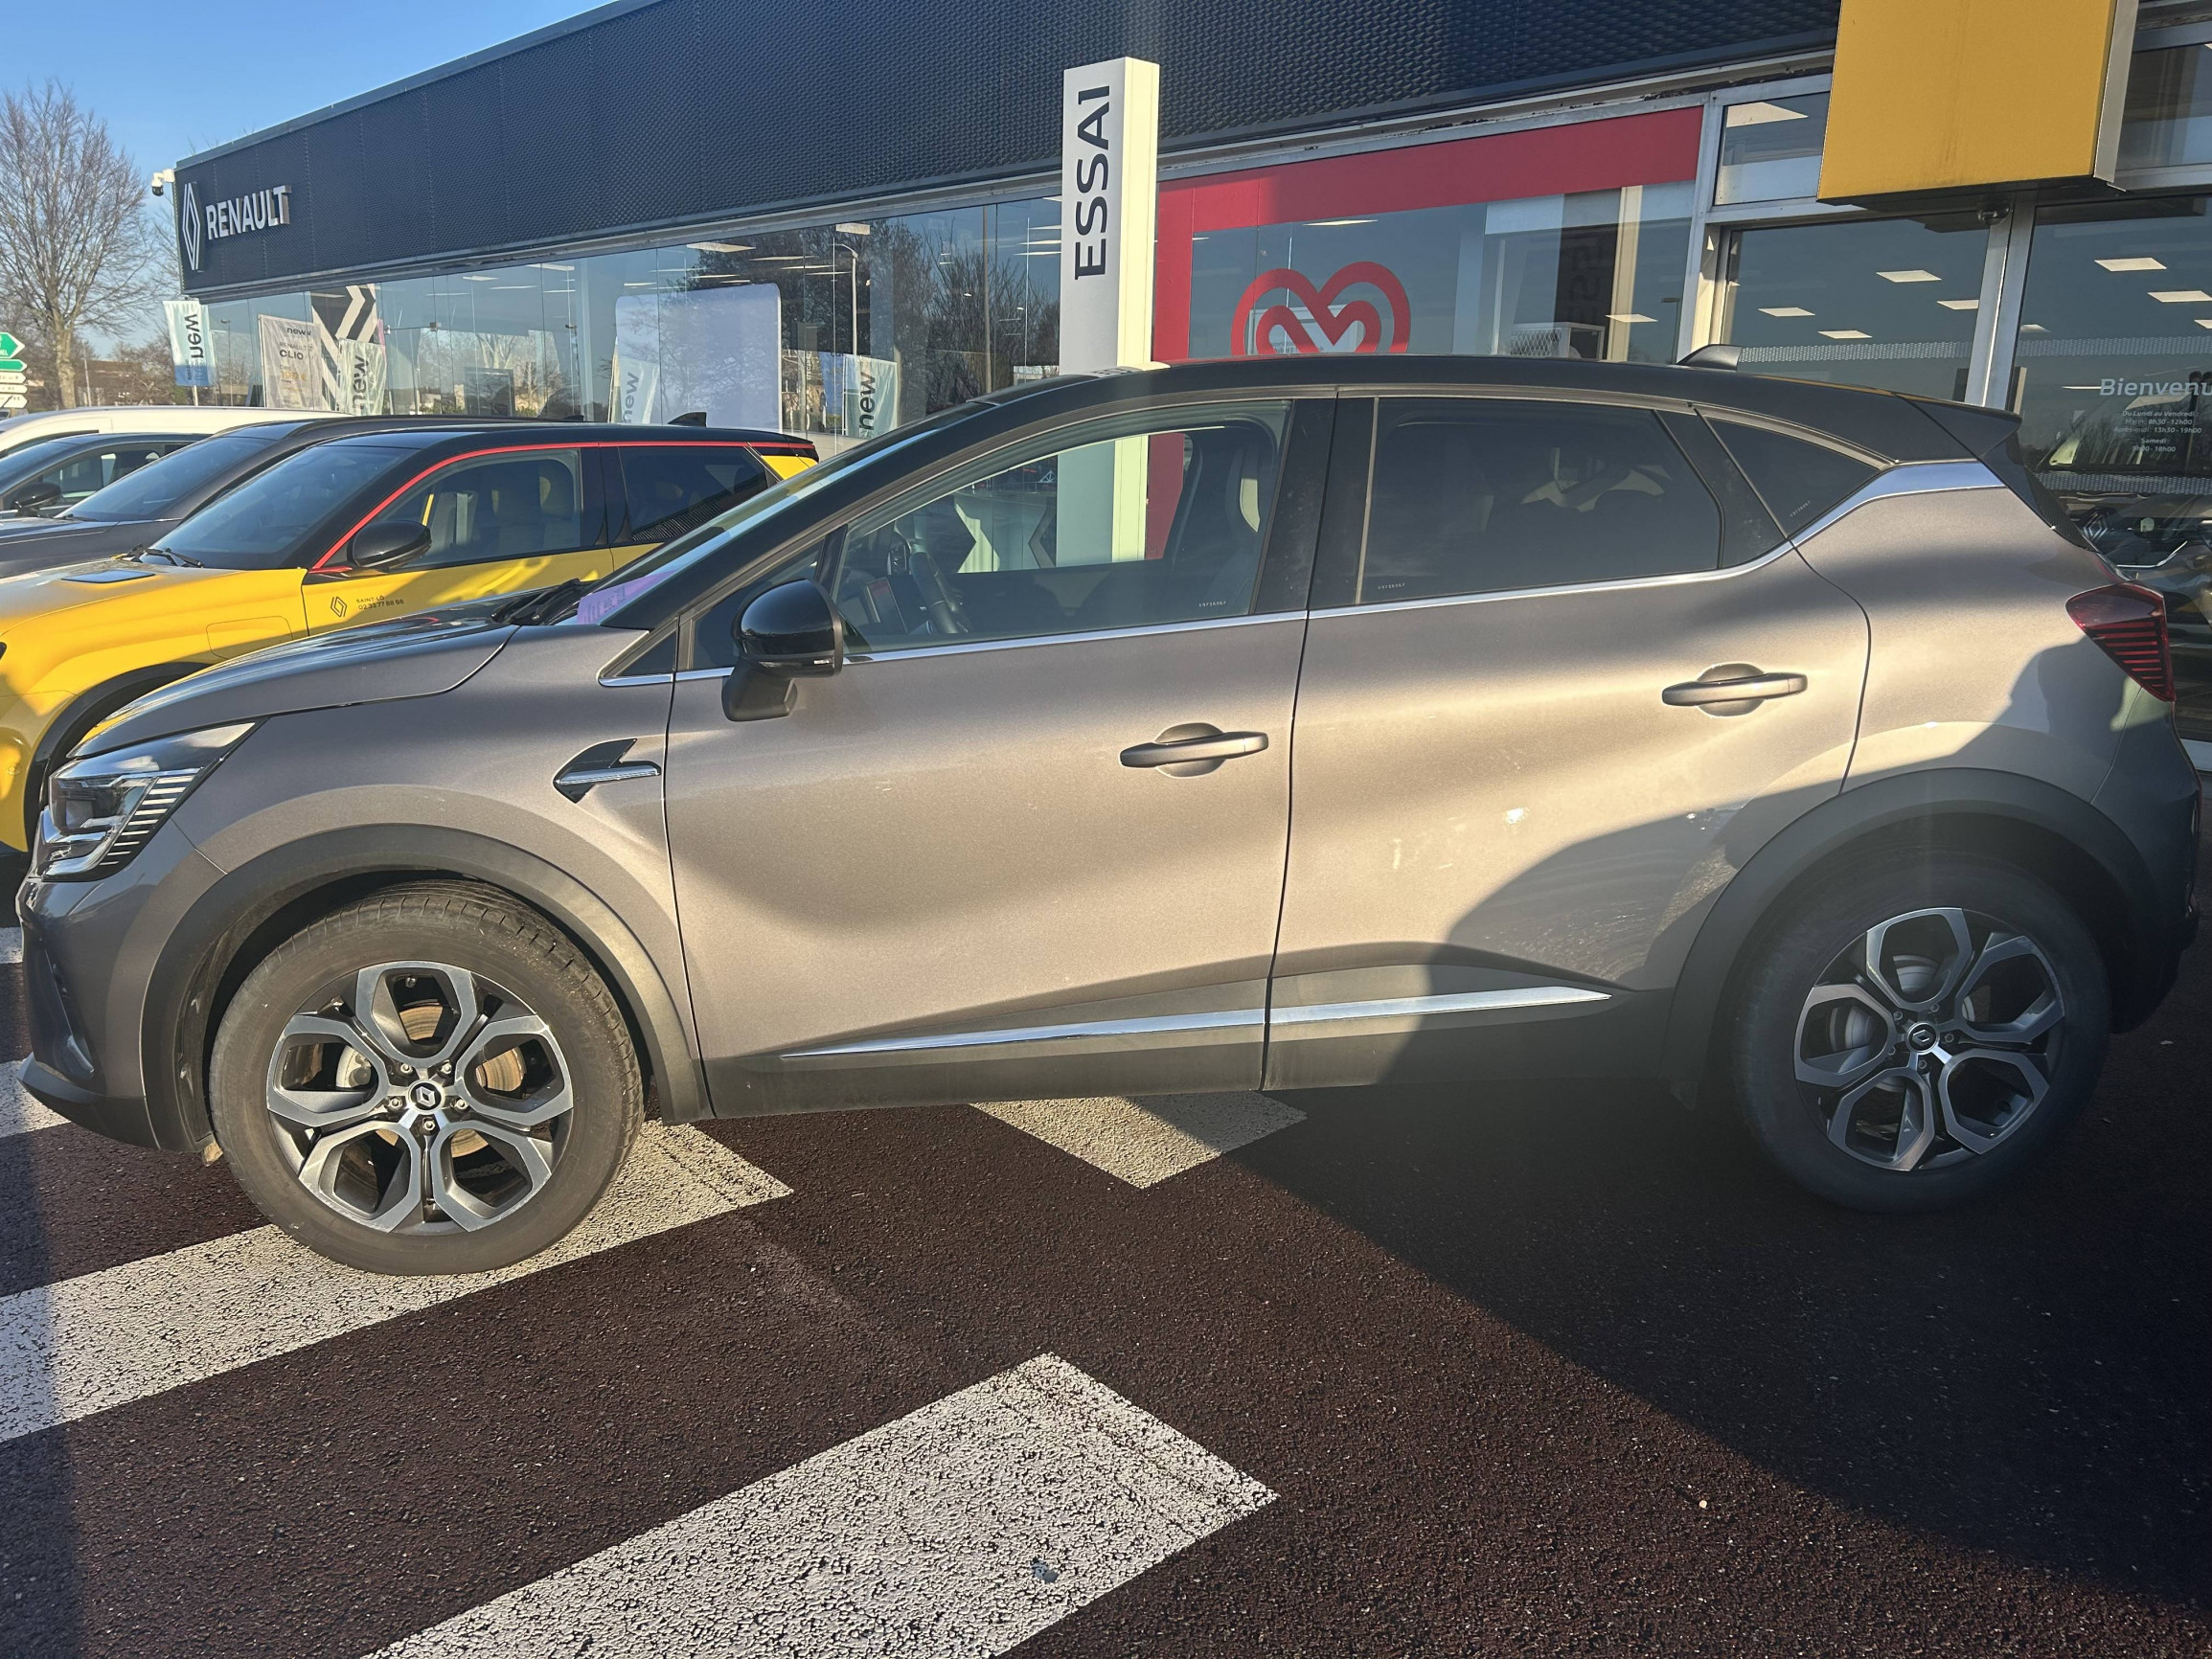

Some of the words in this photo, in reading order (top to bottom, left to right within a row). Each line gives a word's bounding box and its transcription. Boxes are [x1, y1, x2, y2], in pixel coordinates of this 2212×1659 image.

[1074, 84, 1110, 281] ESSAI
[205, 185, 288, 240] RENAULT
[279, 349, 304, 360] CLIO
[287, 327, 307, 335] new
[353, 355, 369, 410] new
[623, 372, 639, 423] new
[858, 372, 876, 431] new
[2099, 377, 2212, 397] Bienvenu
